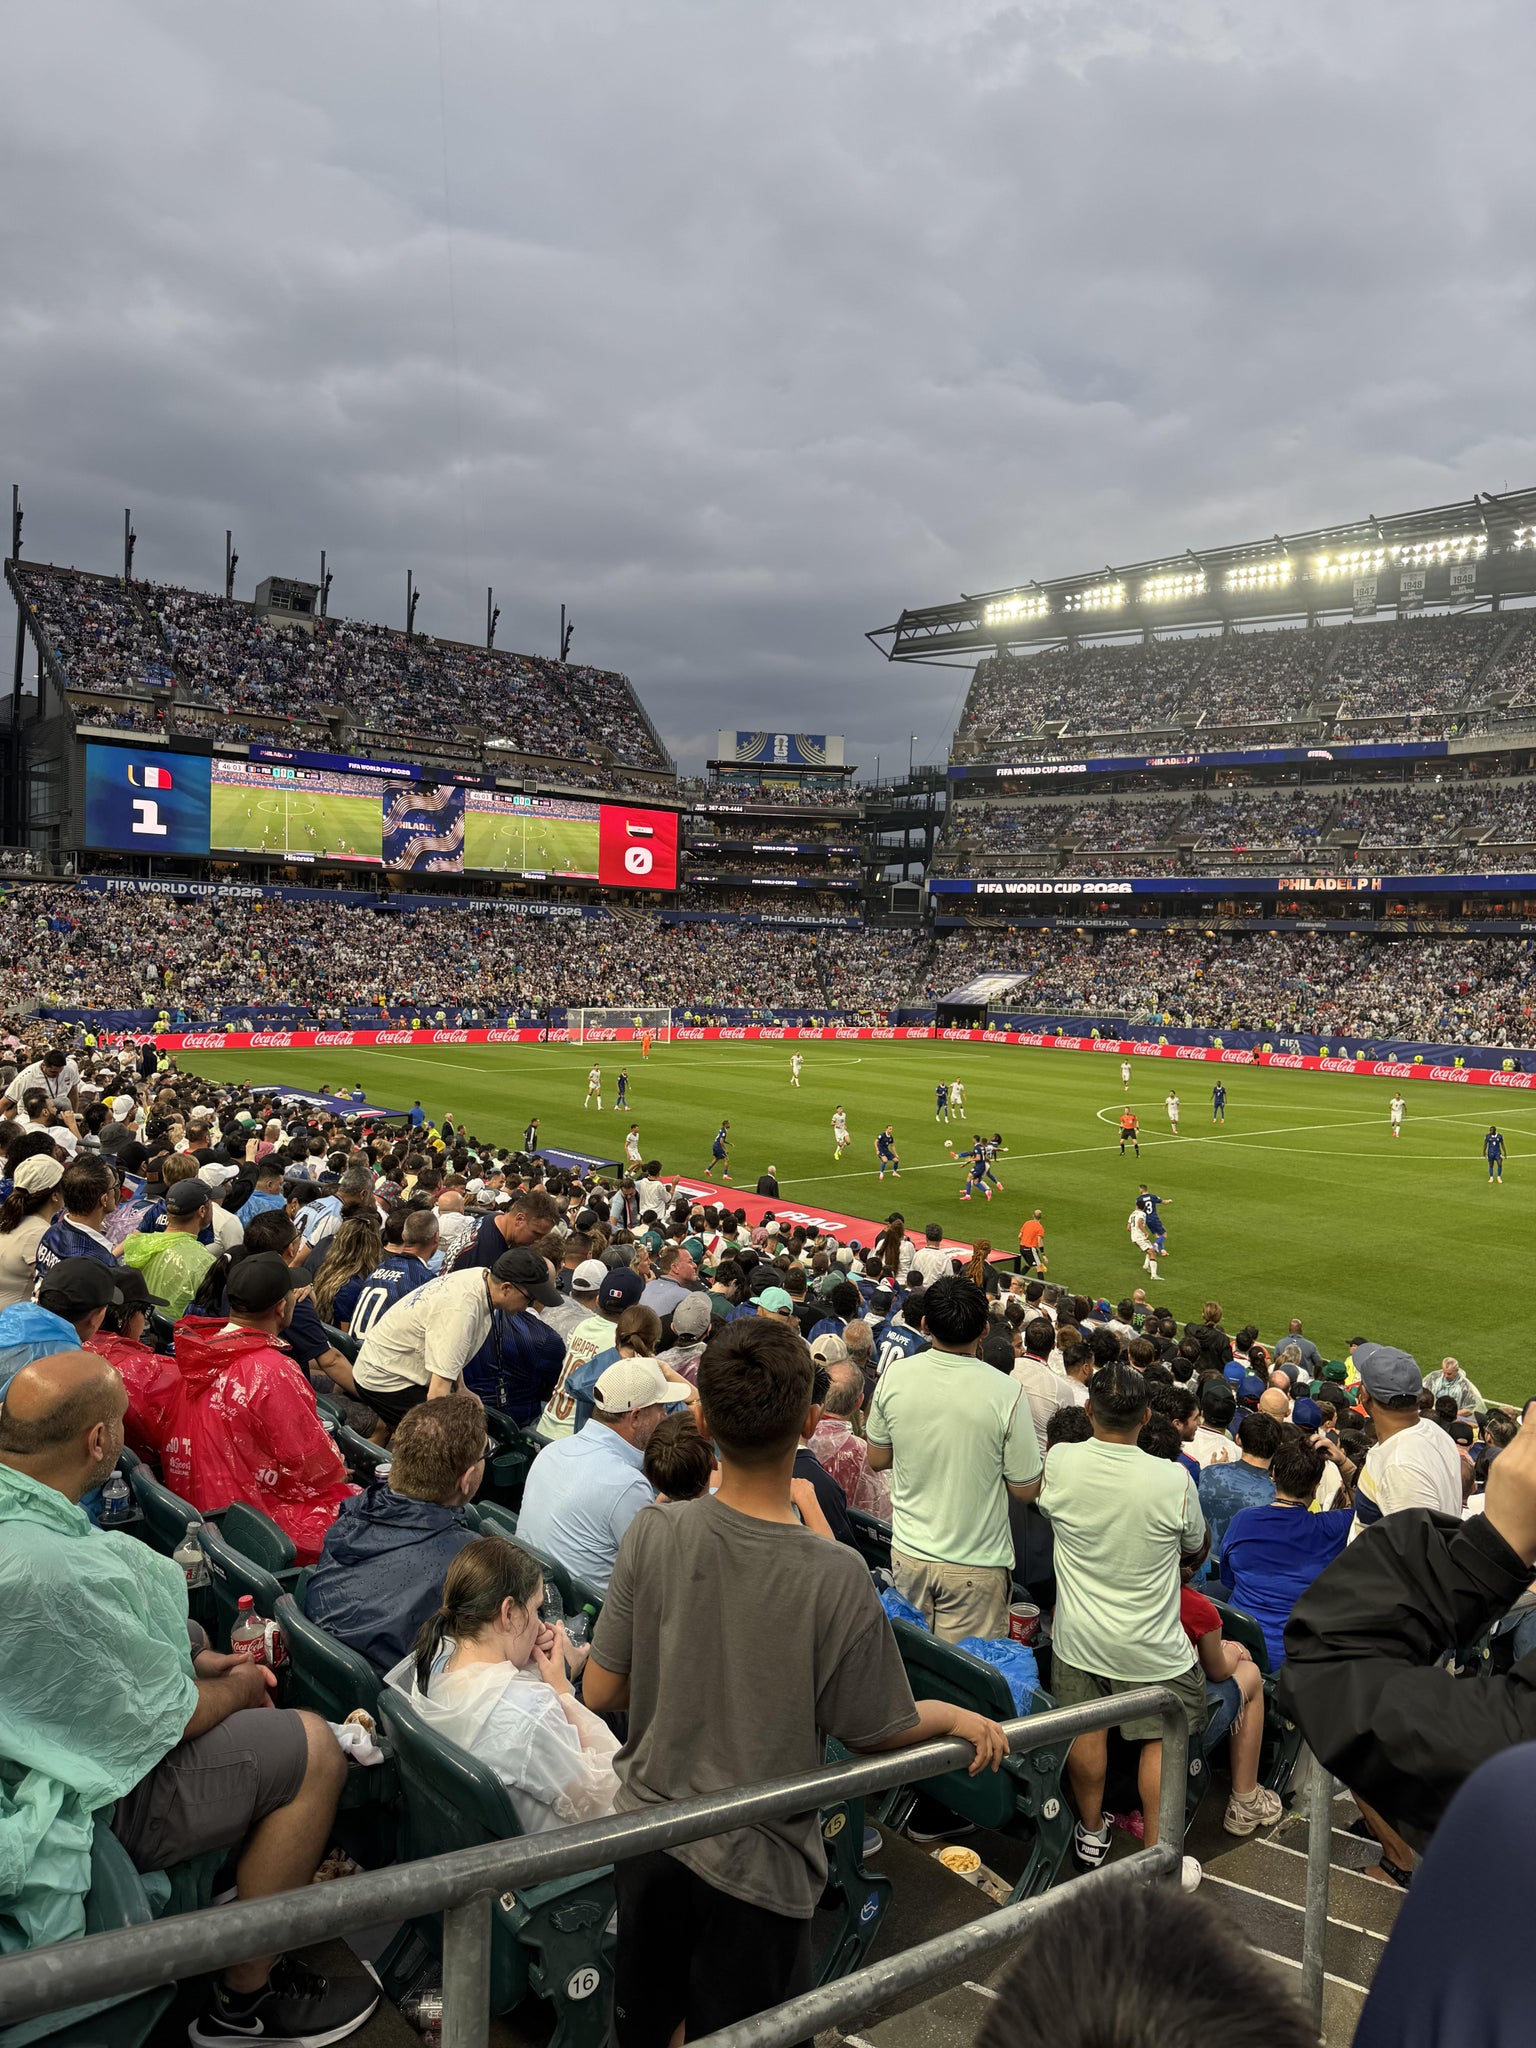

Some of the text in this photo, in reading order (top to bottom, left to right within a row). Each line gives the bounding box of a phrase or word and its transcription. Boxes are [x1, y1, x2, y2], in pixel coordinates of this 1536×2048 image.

[996, 768, 1013, 776] FIFA
[1013, 766, 1041, 776] WORLD
[1041, 766, 1058, 774] CUP
[133, 799, 167, 835] 1
[284, 853, 315, 863] Hisense
[624, 846, 653, 875] 0
[521, 872, 546, 880] Hisense
[106, 879, 264, 898] FIFA WORLD CUP 2026
[976, 883, 1133, 894] FIFA WORLD CUP 2026
[469, 901, 491, 911] FIFA
[531, 905, 549, 915] CUP
[549, 906, 583, 917] 2026
[761, 915, 848, 925] PHILADELPHIA
[1055, 919, 1130, 927] PHILADELPHIA
[250, 1032, 293, 1047] Coca-Cola
[314, 1031, 355, 1046] Coca-Cola
[376, 1030, 415, 1044] Coca-Cola
[433, 1030, 469, 1042] Coca-Cola
[487, 1029, 521, 1042] Coca-Cola
[676, 1028, 705, 1040] Coca-Cola
[1280, 1038, 1298, 1048] FIFA
[1268, 1053, 1304, 1068] Coca-Cola
[1320, 1058, 1356, 1073] Coca-Cola
[1374, 1062, 1412, 1078] Coca-Cola
[1430, 1066, 1470, 1083] Coca-Cola
[1489, 1071, 1532, 1088] Coca-Cola
[1144, 1201, 1153, 1215] 3
[774, 1210, 848, 1231] IRAQ
[370, 1268, 405, 1283] MBAPPE
[349, 1286, 388, 1340] 10
[886, 1330, 911, 1346] MBAPPE
[571, 1336, 600, 1358] MBAPPE
[1190, 1760, 1200, 1774] 13
[1046, 1800, 1057, 1815] 14
[826, 1818, 842, 1834] 15
[1081, 1844, 1100, 1856] PUMA
[573, 1972, 594, 1994] 16
